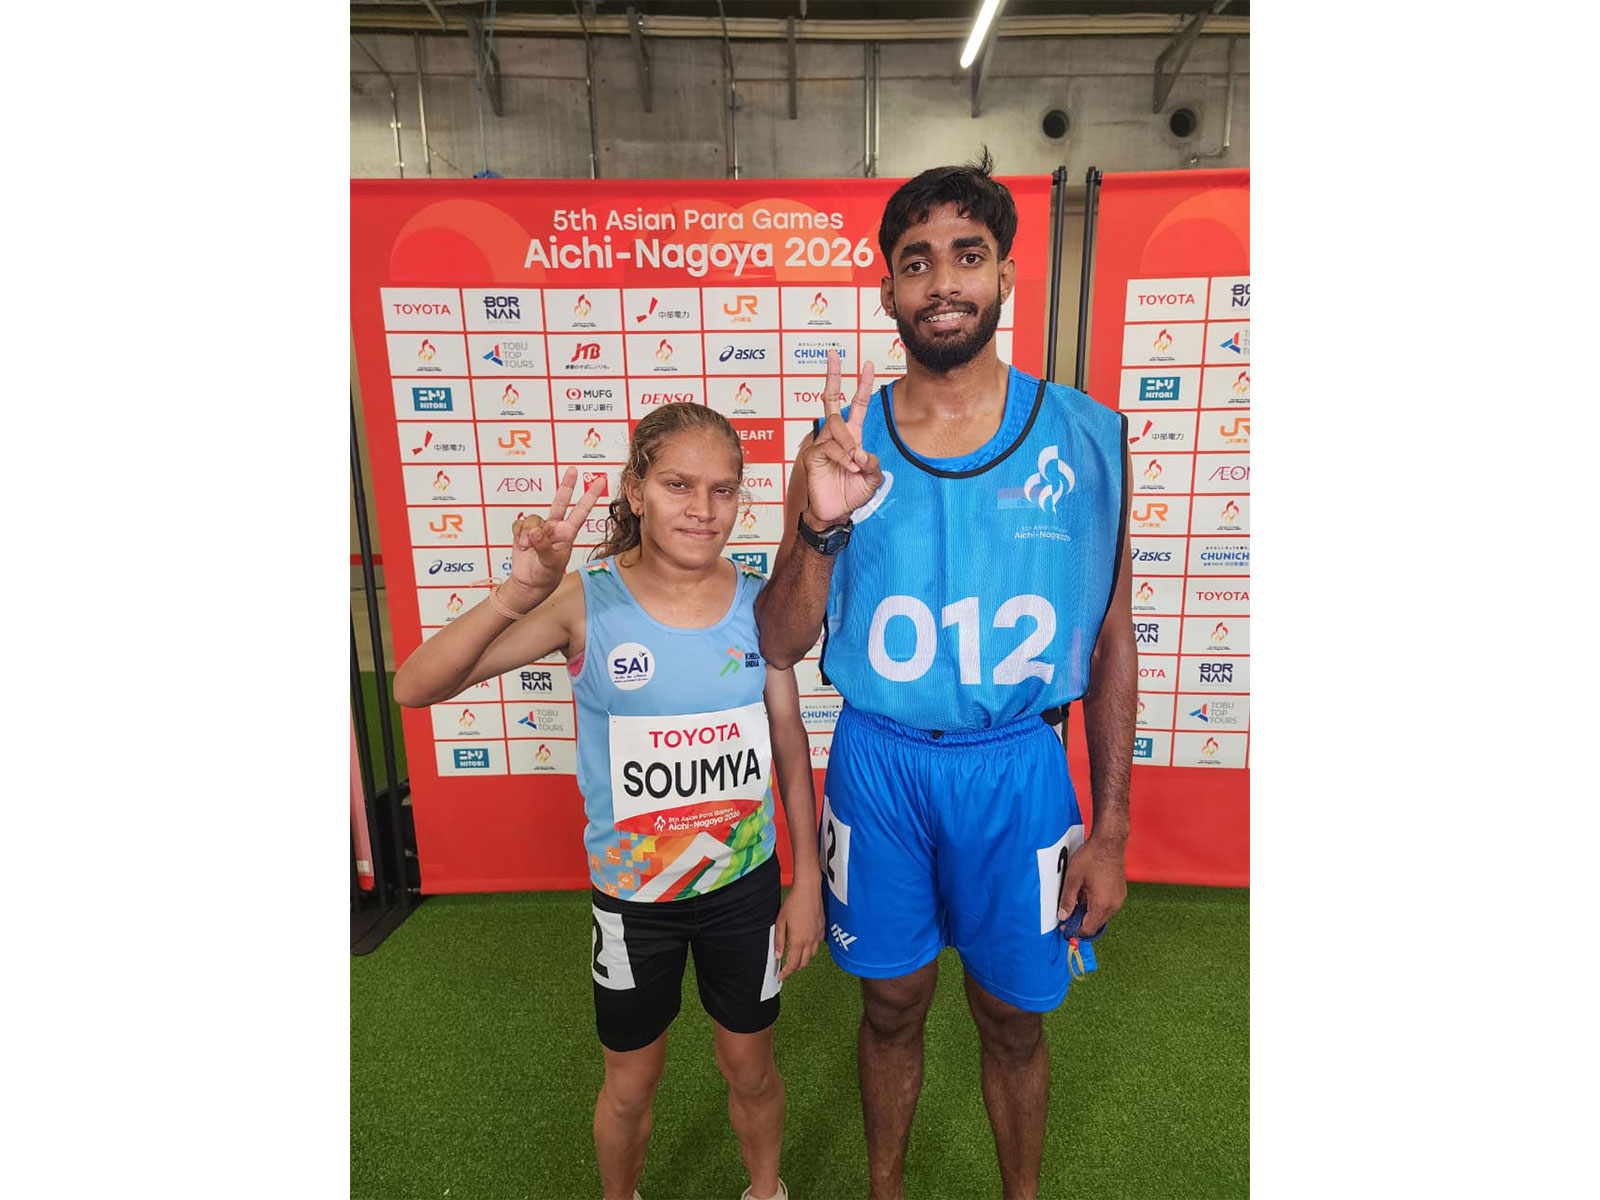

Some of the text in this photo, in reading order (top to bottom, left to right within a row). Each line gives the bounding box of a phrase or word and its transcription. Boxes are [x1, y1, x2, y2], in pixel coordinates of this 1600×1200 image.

[553, 207, 844, 231] 5th Asian Para Games
[523, 235, 875, 277] Aichi-Nagoya 2026
[483, 296, 519, 307] BOR
[723, 295, 759, 316] JR
[1138, 294, 1195, 306] TOYOTA
[393, 304, 451, 315] TOYOTA
[486, 308, 521, 319] NAN
[503, 342, 528, 350] TOBU
[503, 351, 522, 359] TOP
[571, 343, 601, 363] JTB
[735, 349, 766, 361] asics
[794, 349, 846, 358] CHUNIHI
[504, 360, 534, 368] TOURS
[1146, 379, 1174, 390] ニトリ
[419, 389, 446, 401] ニトリ
[583, 389, 613, 398] MUFG
[640, 393, 694, 405] DENSO
[794, 392, 847, 403] TOYA
[1146, 391, 1173, 399] NITORI
[498, 430, 532, 449] JR
[1132, 503, 1168, 521] JR
[429, 514, 463, 532] JR
[1139, 551, 1172, 562] asics
[1200, 552, 1250, 560] CHUNICH
[443, 562, 475, 572] asics
[1196, 591, 1250, 601] TOYOTA
[1133, 623, 1159, 633] OR
[868, 594, 1057, 685] 012
[1136, 634, 1159, 643] AN
[613, 656, 649, 675] SAI
[1198, 663, 1234, 673] BOR
[520, 671, 551, 681] BOR
[1200, 674, 1233, 683] NAN
[522, 682, 553, 691] NAN
[649, 722, 741, 749] TOYOTA
[459, 750, 484, 760] ニトリ
[623, 748, 761, 799] SOUMYA
[668, 817, 723, 831] Aichi-Nagoya
[828, 819, 836, 884] 2
[592, 913, 610, 979] 2
